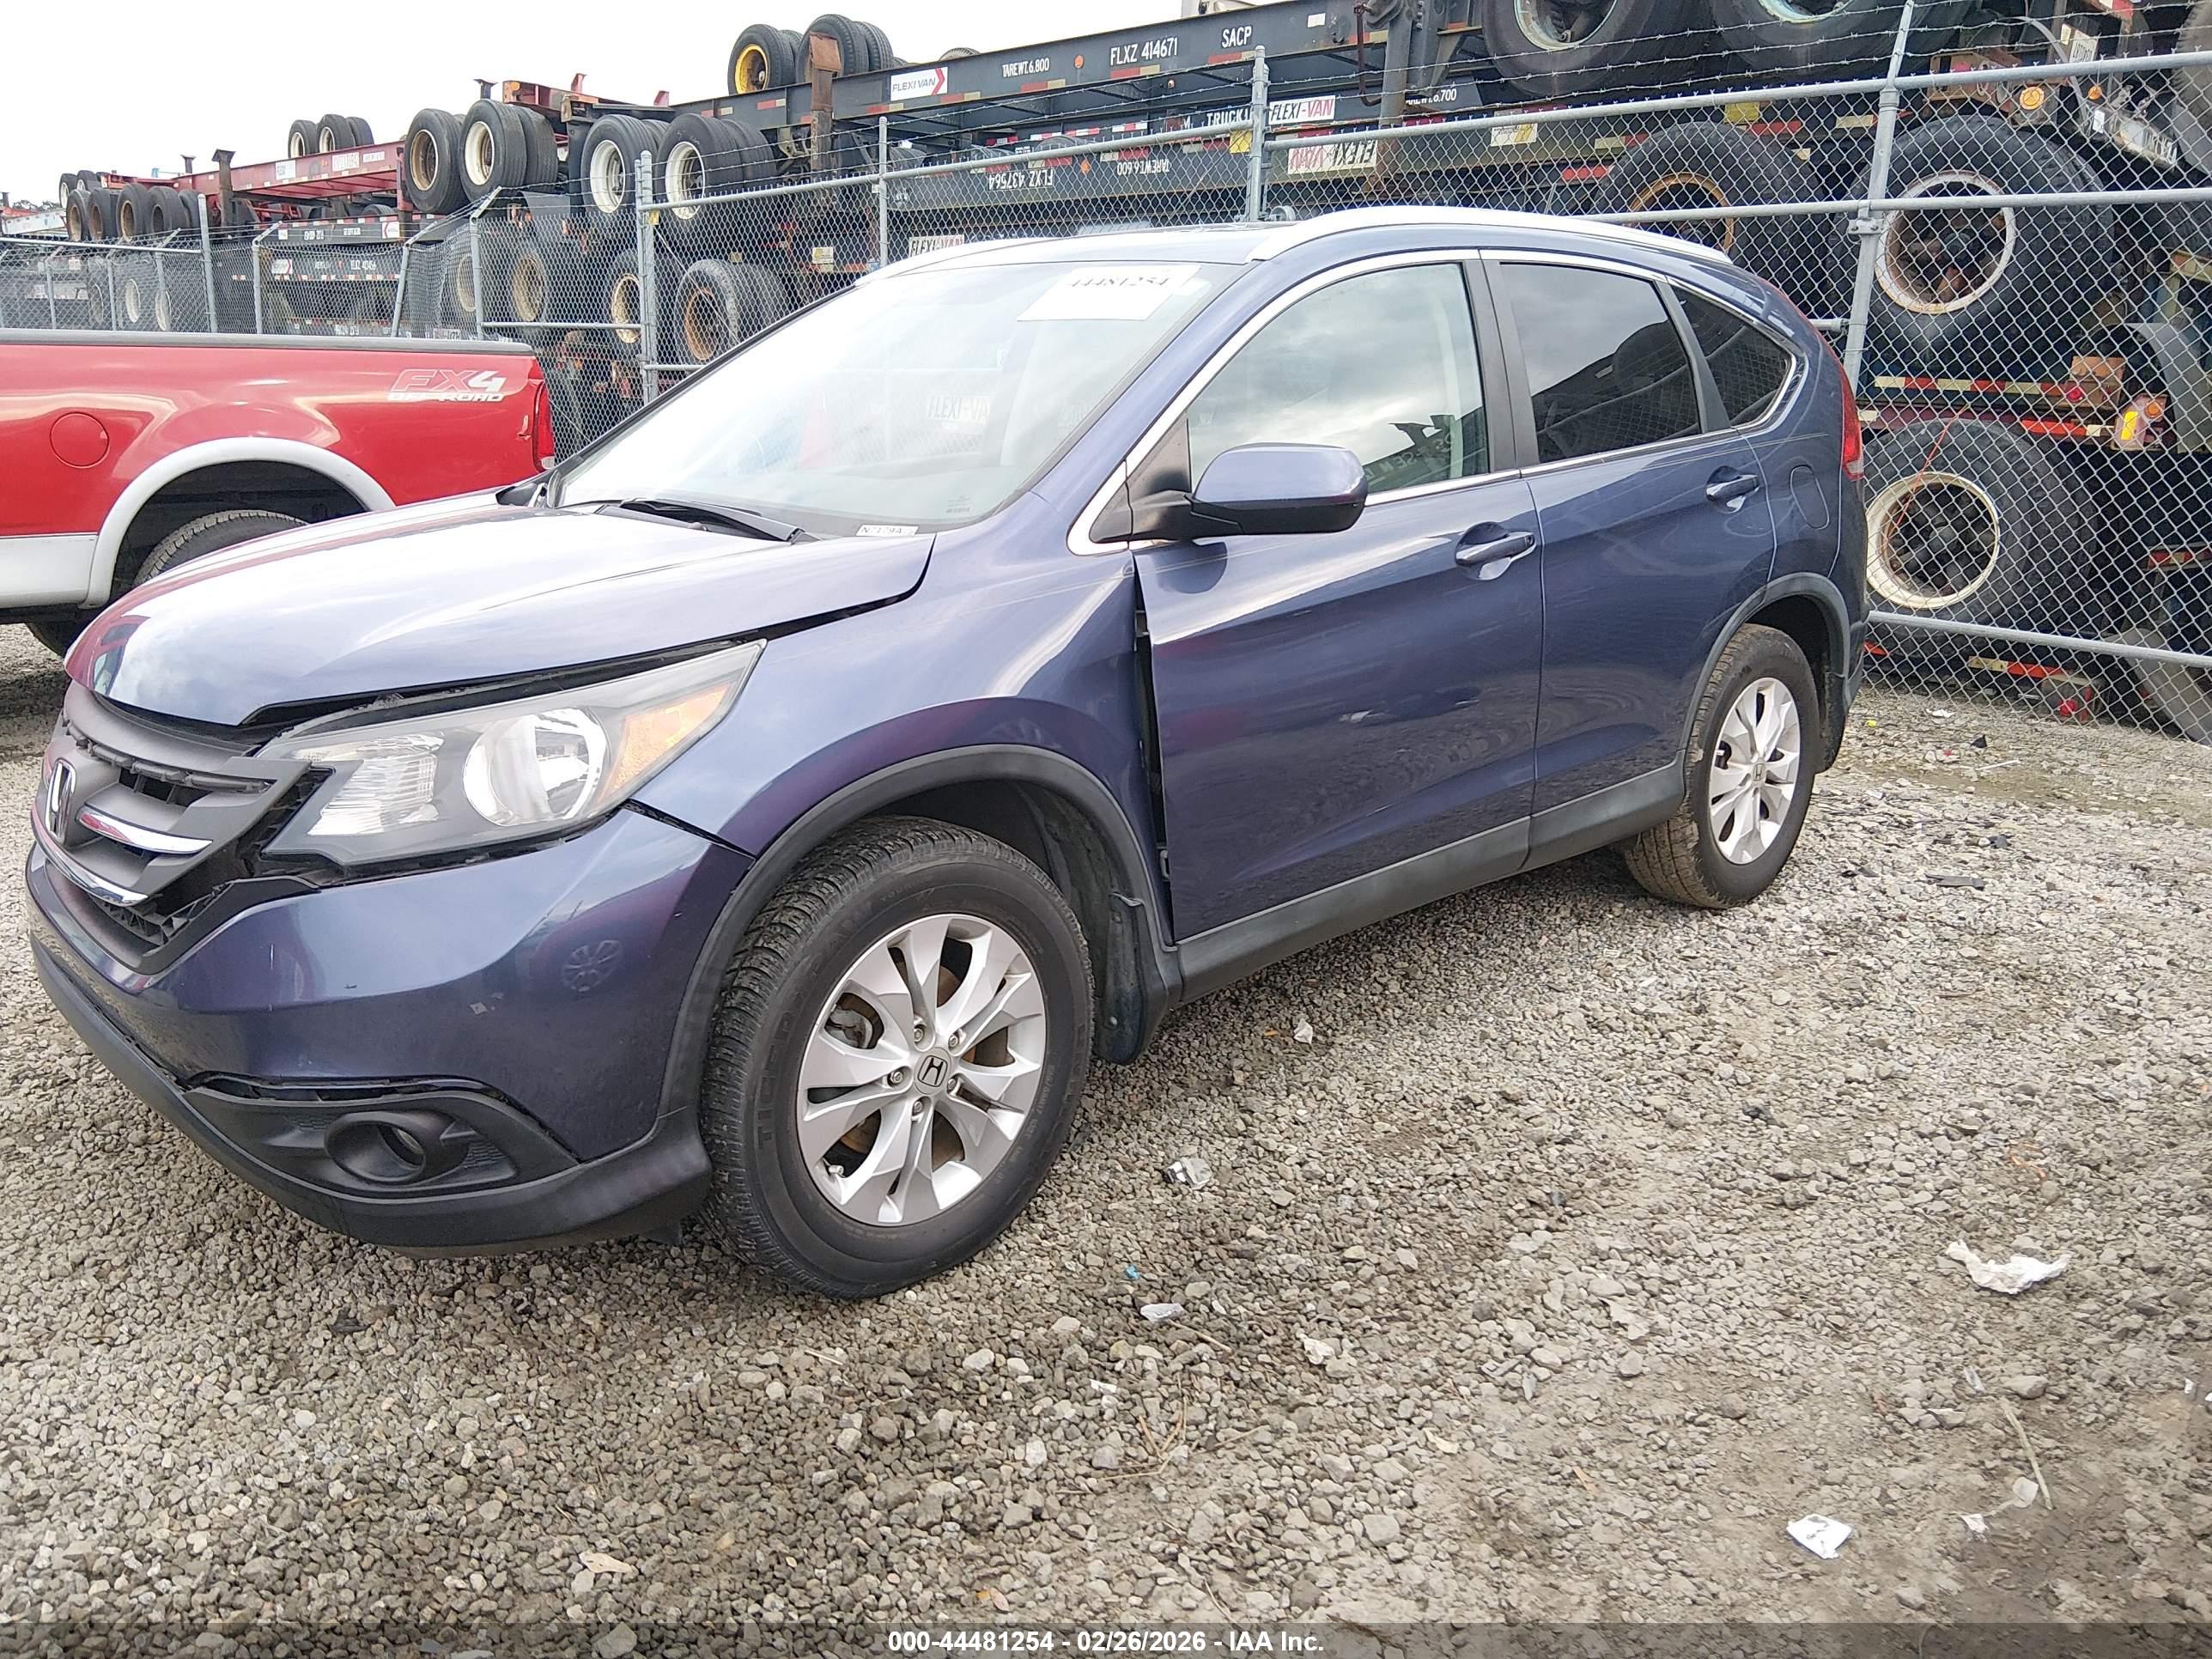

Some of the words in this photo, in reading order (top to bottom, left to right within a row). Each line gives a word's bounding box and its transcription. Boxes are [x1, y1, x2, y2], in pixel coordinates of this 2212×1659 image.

[1221, 26, 1253, 49] SACP
[1109, 43, 1139, 66] FLXZ
[1140, 36, 1179, 61] 414671
[1270, 99, 1334, 122] FLEXI-VAN
[988, 171, 1025, 191] 437564
[1029, 168, 1054, 187] FLXZ
[390, 368, 507, 392] FX4
